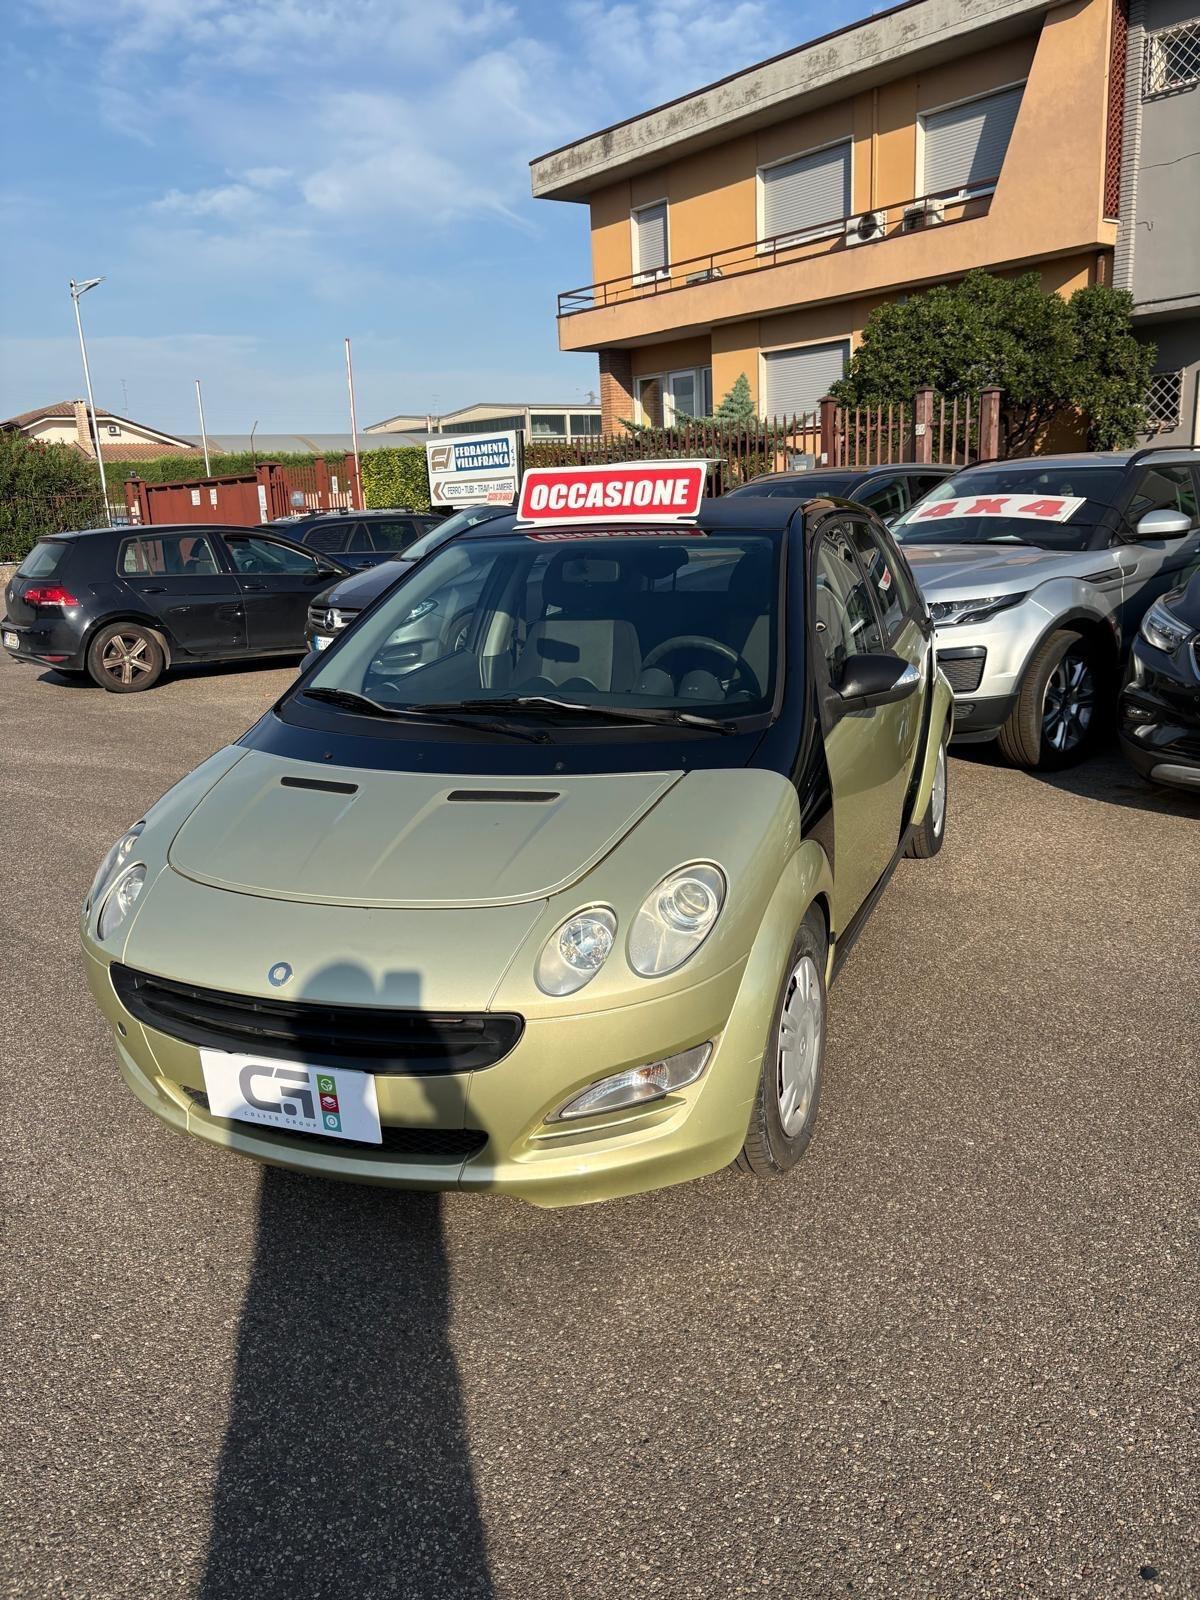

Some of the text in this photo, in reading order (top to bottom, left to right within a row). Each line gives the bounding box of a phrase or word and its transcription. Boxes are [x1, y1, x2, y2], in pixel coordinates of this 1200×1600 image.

[455, 441, 508, 458] FERRAMENTA
[456, 453, 509, 468] VILLAFRANCA
[447, 486, 461, 495] FERRO
[529, 479, 690, 511] OCCASIONE
[285, 1118, 317, 1128] GROUP
